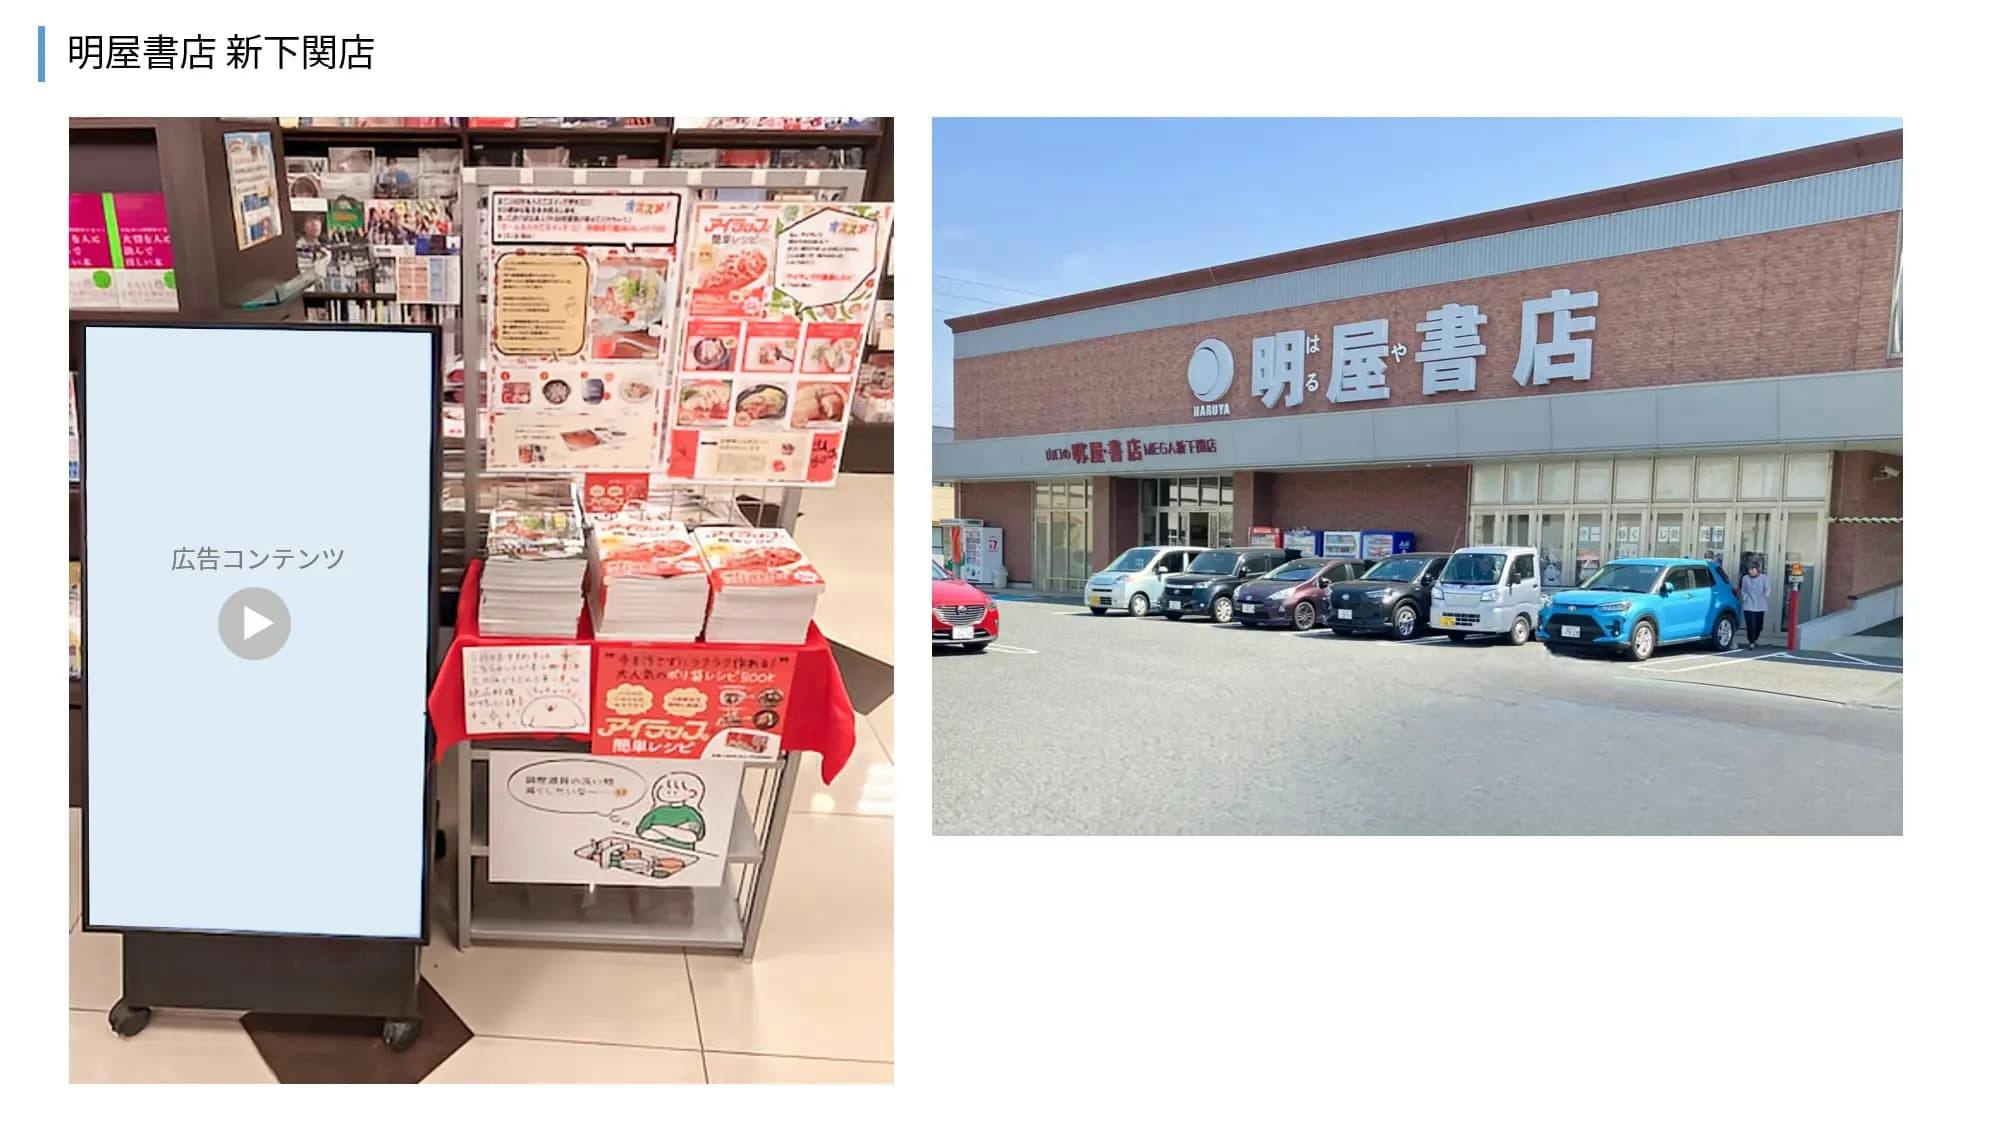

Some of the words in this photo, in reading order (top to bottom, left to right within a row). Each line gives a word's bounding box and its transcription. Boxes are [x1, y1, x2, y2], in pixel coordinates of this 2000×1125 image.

[1251, 288, 1599, 410] 明屋書店
[1193, 403, 1230, 417] HARUYA
[598, 717, 710, 741] アイラップ
[612, 738, 697, 755] 簡単レシピ
